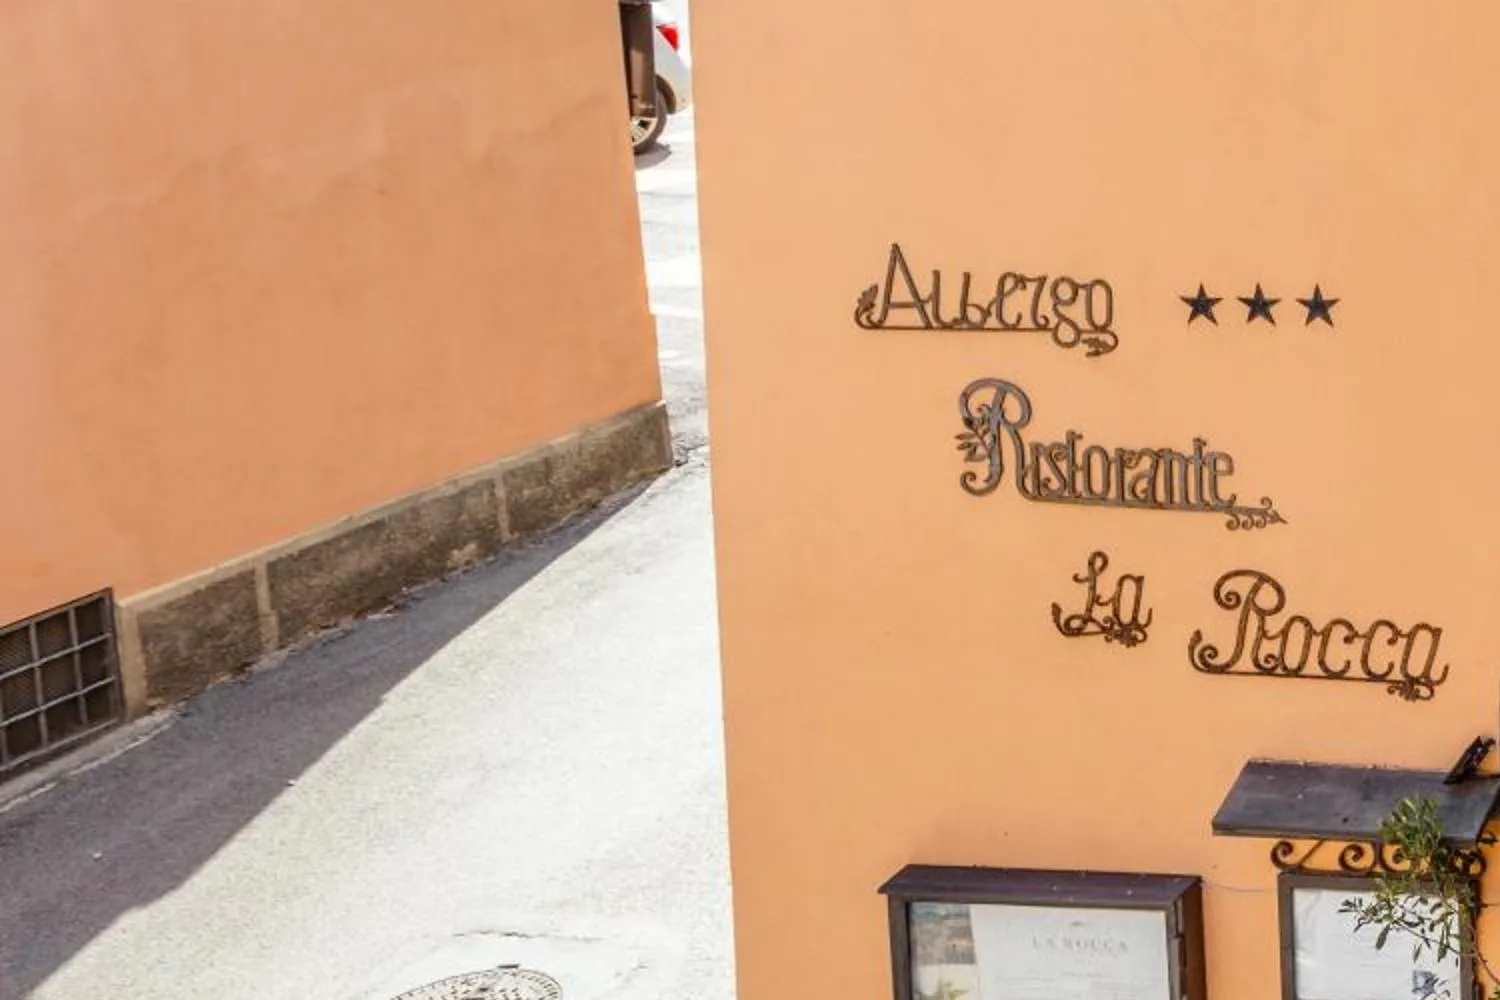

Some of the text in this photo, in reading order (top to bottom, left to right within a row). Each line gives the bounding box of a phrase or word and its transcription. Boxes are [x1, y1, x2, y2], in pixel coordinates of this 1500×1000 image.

[855, 243, 1119, 355] Albergo
[954, 377, 1256, 518] Ristorante
[1051, 551, 1449, 695] La Rocca
